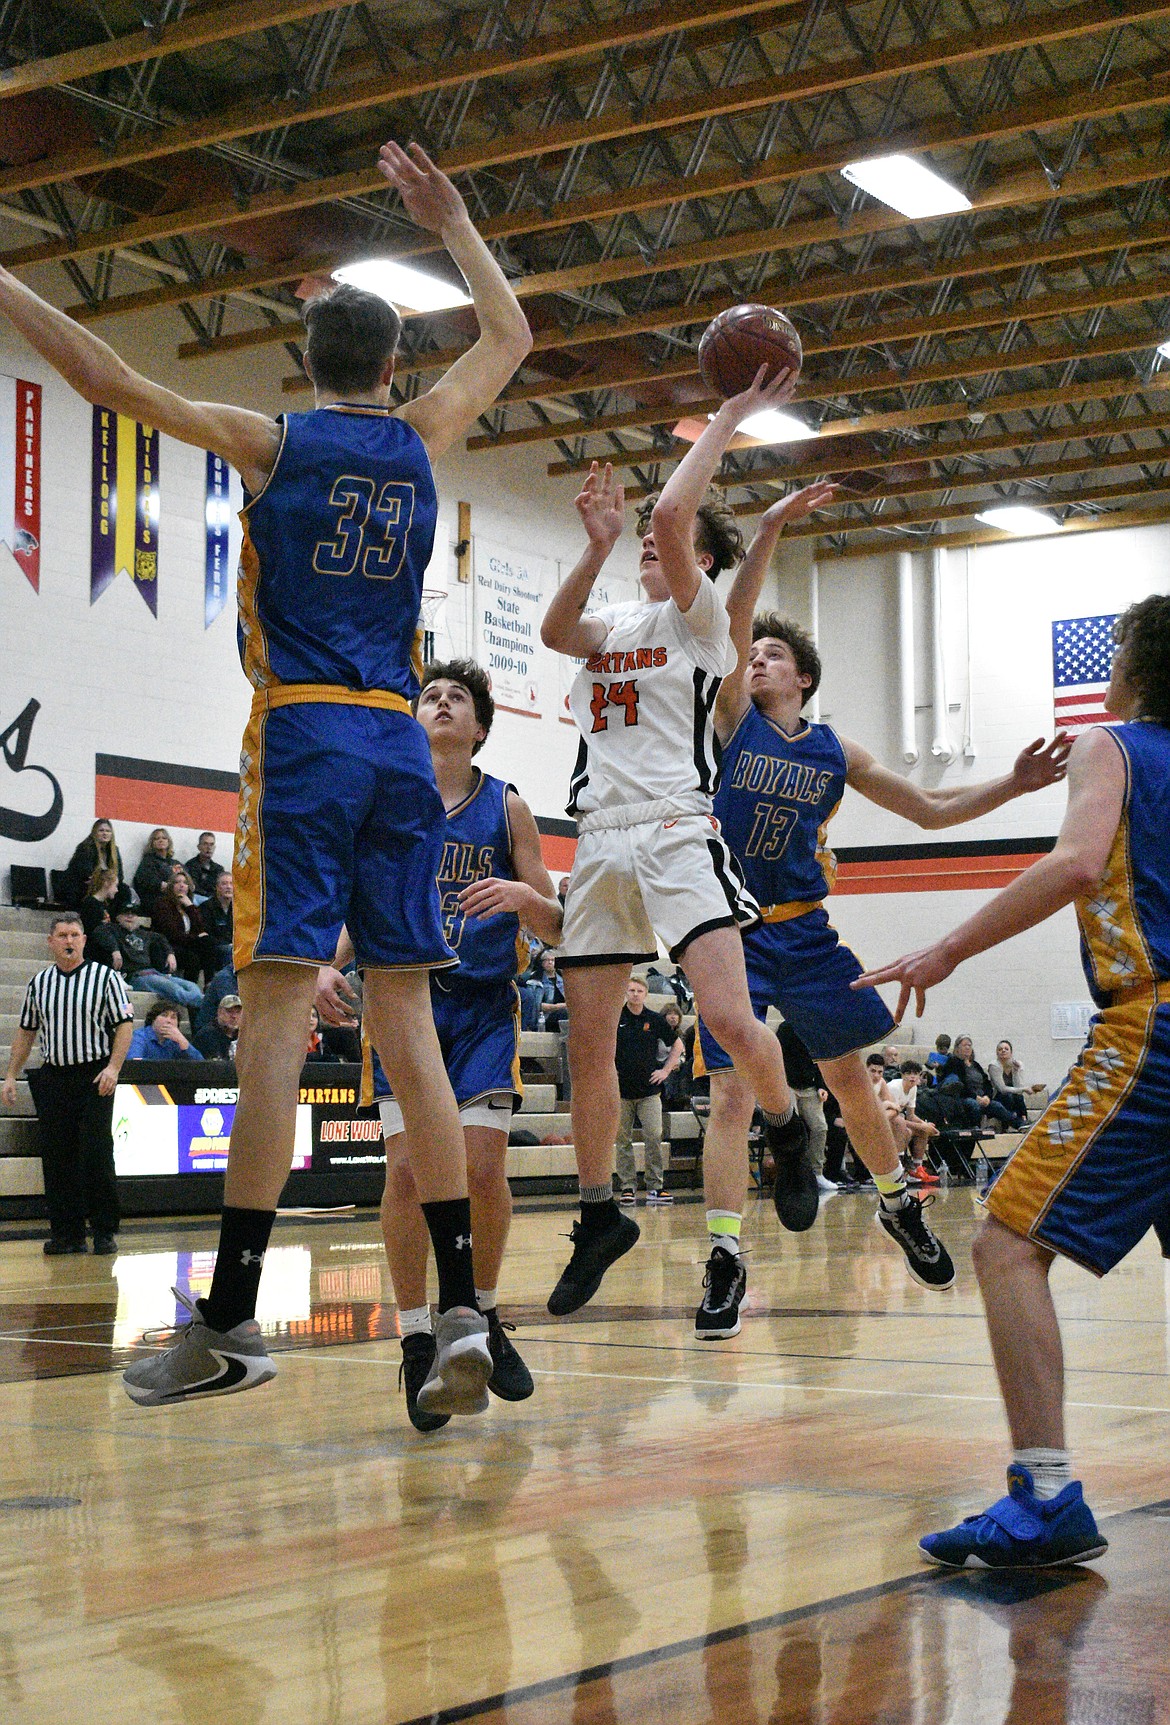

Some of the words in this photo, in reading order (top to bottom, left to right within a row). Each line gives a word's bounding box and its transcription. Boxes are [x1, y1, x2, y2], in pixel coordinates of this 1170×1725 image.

[24, 389, 35, 517] PANTHERS
[101, 411, 110, 536] KELLOGG
[312, 474, 415, 580] 33
[497, 596, 520, 615] State
[484, 611, 532, 637] Basketball
[483, 630, 535, 656] Champions
[489, 652, 528, 676] 2009-10
[731, 749, 833, 805] ROYALS
[745, 802, 800, 861] 13
[437, 841, 495, 883] ALS
[297, 1088, 356, 1105] PARTANS
[320, 1120, 350, 1142] LONE
[350, 1120, 383, 1142] WOLF
